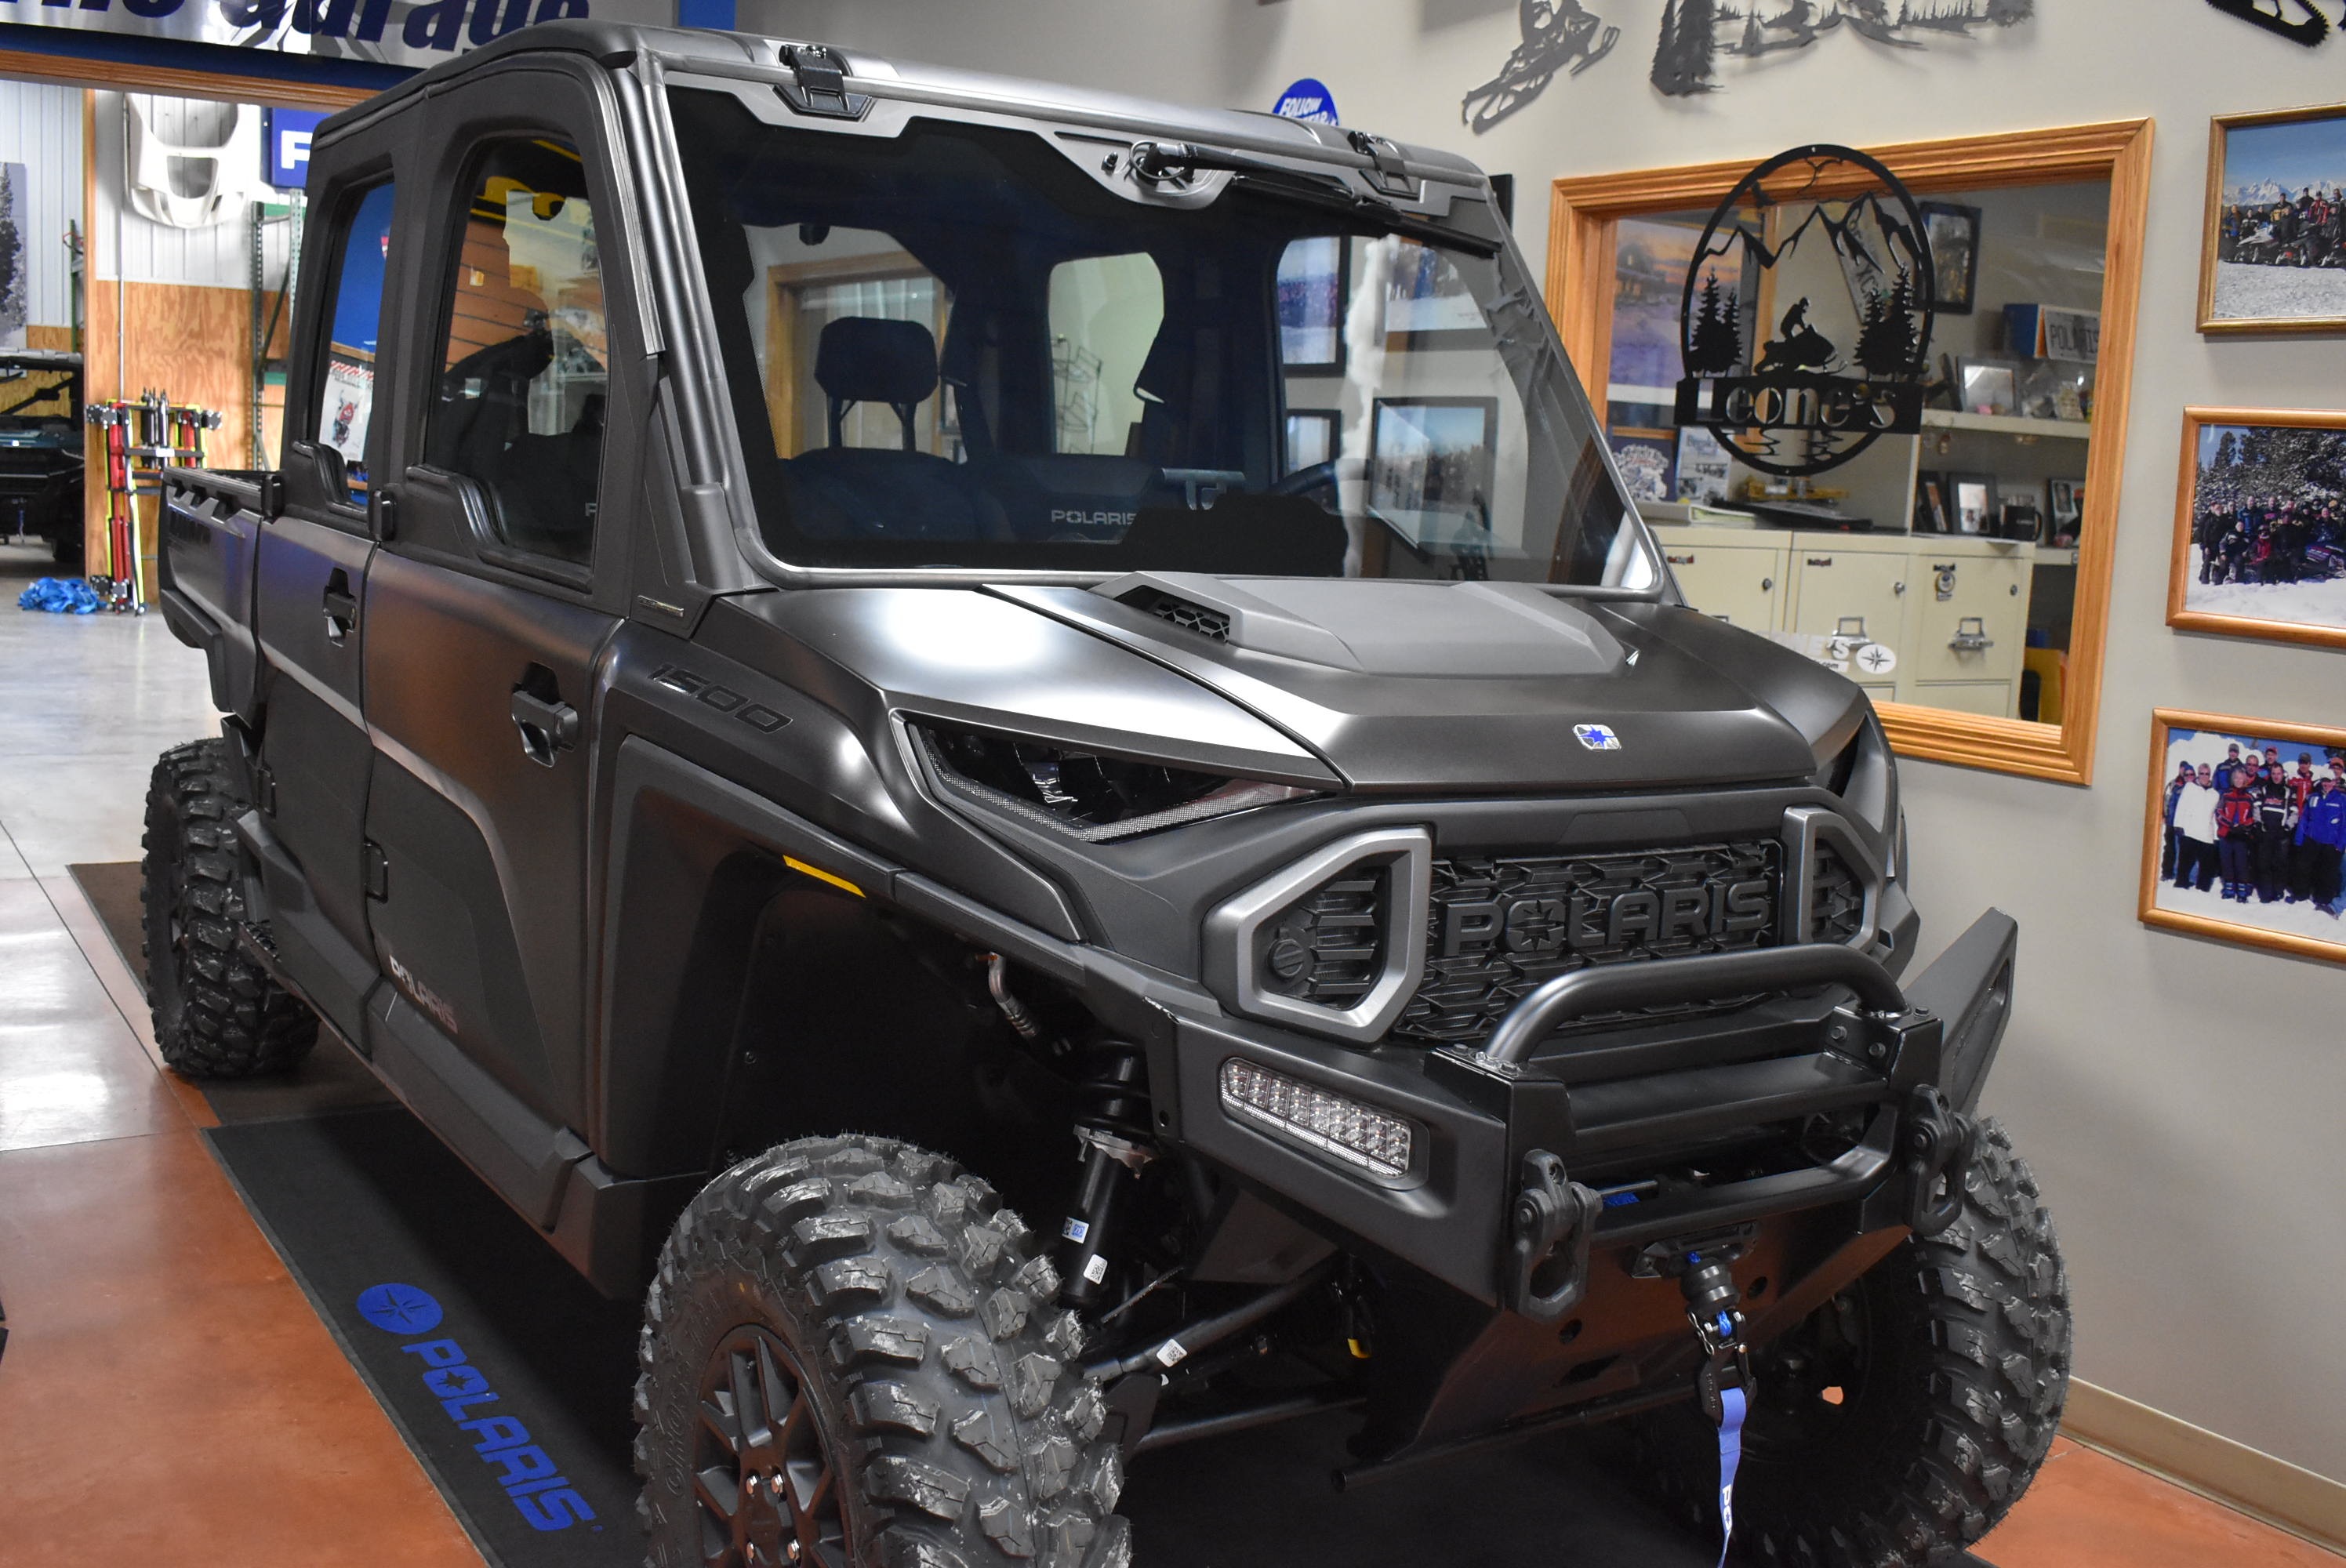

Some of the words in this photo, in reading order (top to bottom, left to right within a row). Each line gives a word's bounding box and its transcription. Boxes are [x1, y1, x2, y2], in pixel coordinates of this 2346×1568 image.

[1279, 97, 1323, 118] FOLLOW
[1695, 378, 1896, 428] Leone's
[1051, 510, 1137, 525] POLARIS
[648, 664, 794, 734] 1500
[1444, 880, 1770, 956] POLARIS
[390, 955, 458, 1034] POLARIS
[401, 1339, 597, 1531] POLARIS
